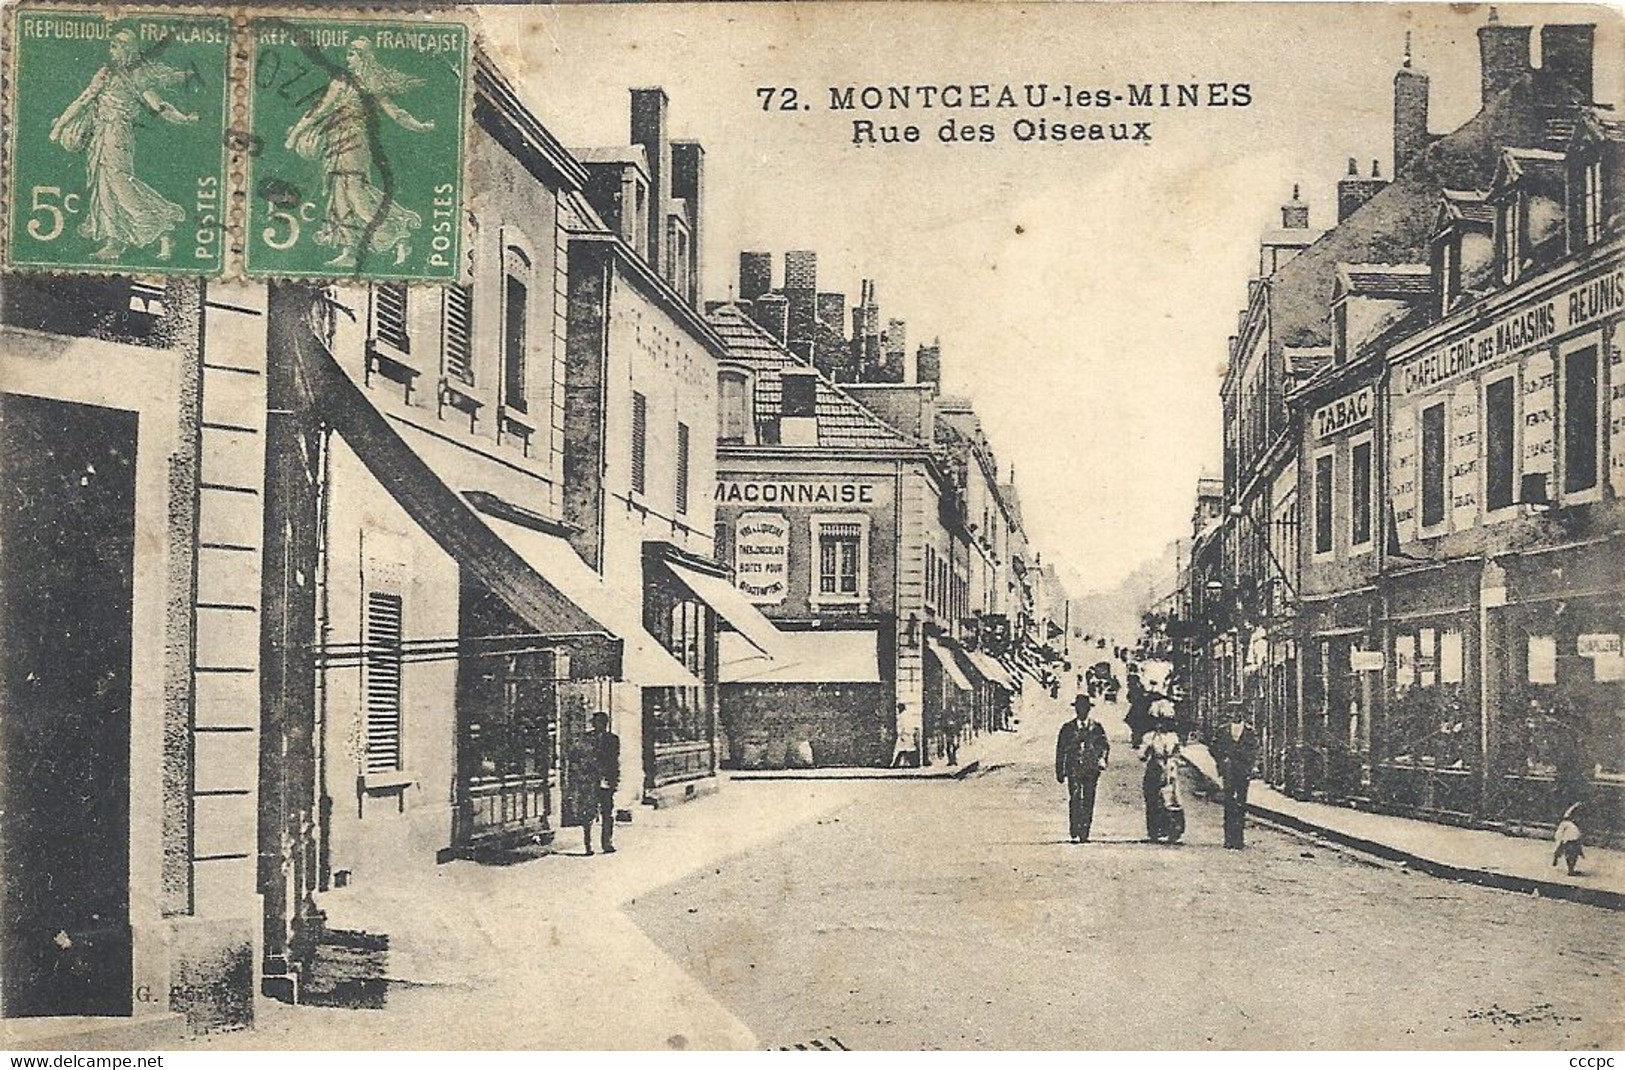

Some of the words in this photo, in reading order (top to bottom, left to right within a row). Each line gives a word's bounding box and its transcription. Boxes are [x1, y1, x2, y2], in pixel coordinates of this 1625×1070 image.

[376, 30, 458, 52] FRANÇAISE
[194, 176, 218, 260] POSTES
[429, 183, 454, 267] POSTES
[1405, 337, 1476, 394] CHAPELLERIE
[1496, 302, 1554, 355] MAGASINS
[1318, 391, 1368, 435] TABAC
